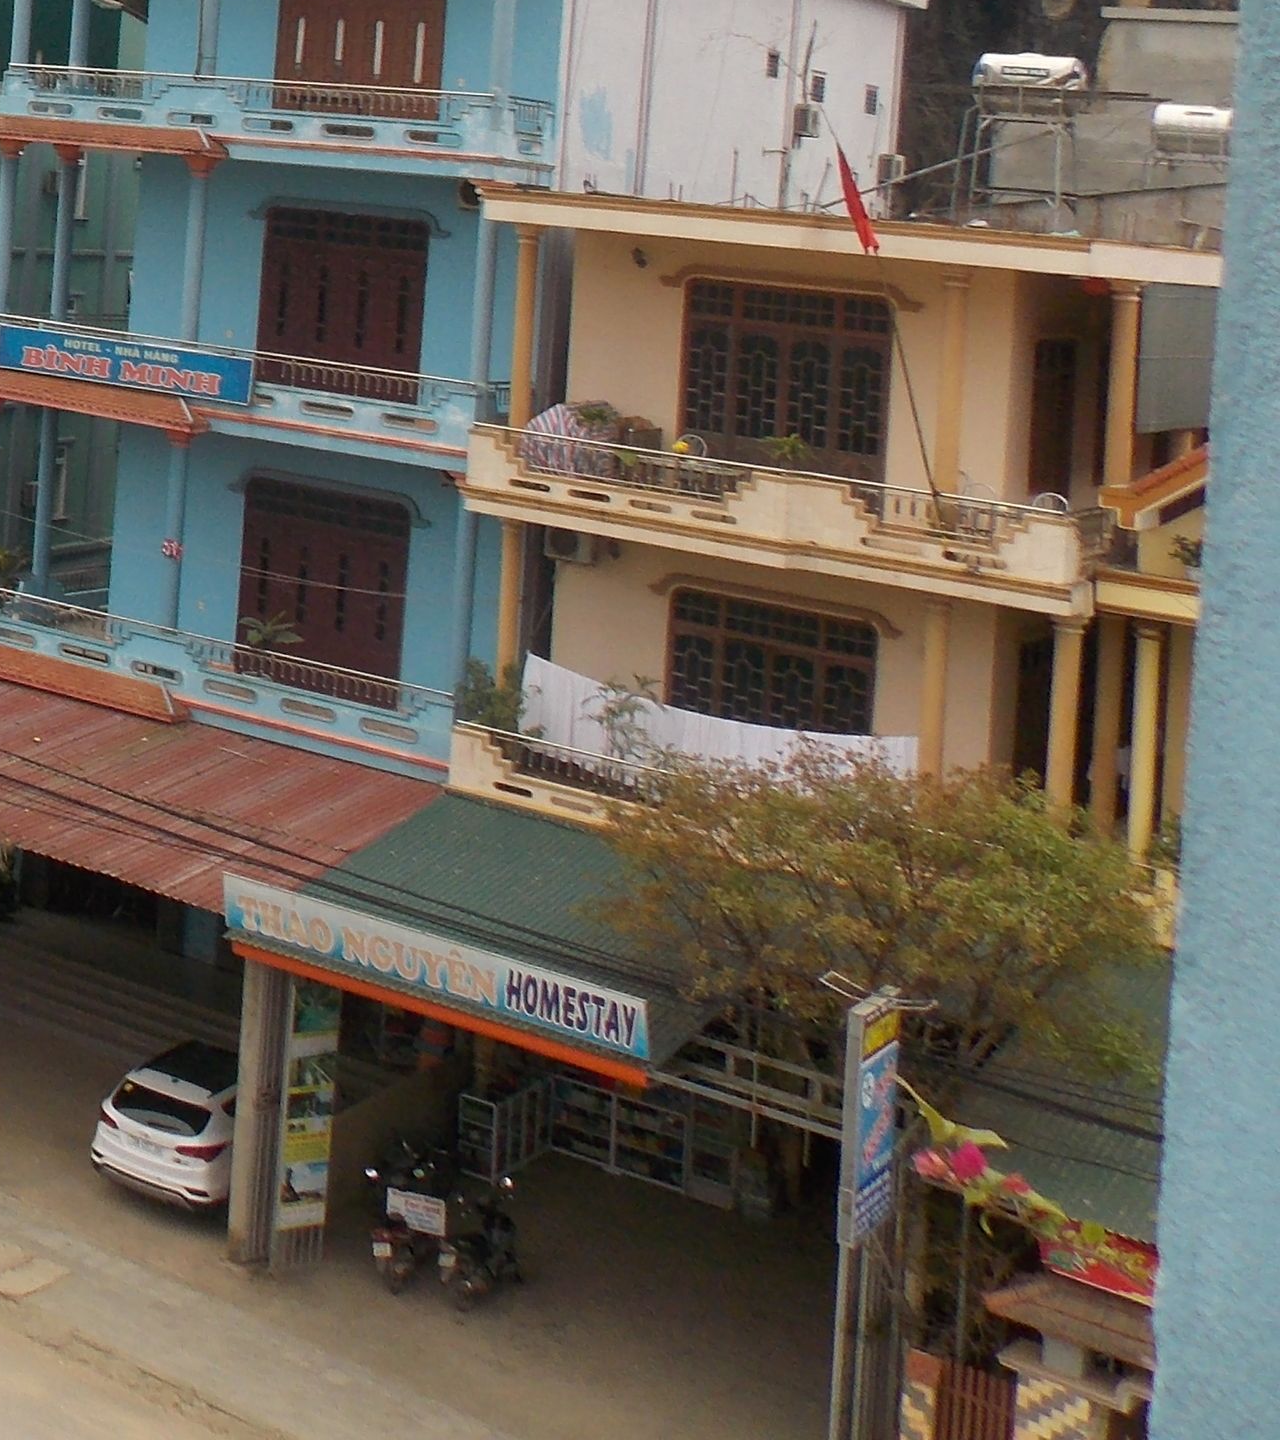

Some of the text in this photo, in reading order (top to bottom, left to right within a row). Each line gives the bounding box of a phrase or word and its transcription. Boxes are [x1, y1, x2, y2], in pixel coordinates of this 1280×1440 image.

[21, 345, 220, 395] BÌNH MINH
[64, 338, 101, 353] HOTEL
[505, 966, 637, 1049] HOMESTAY
